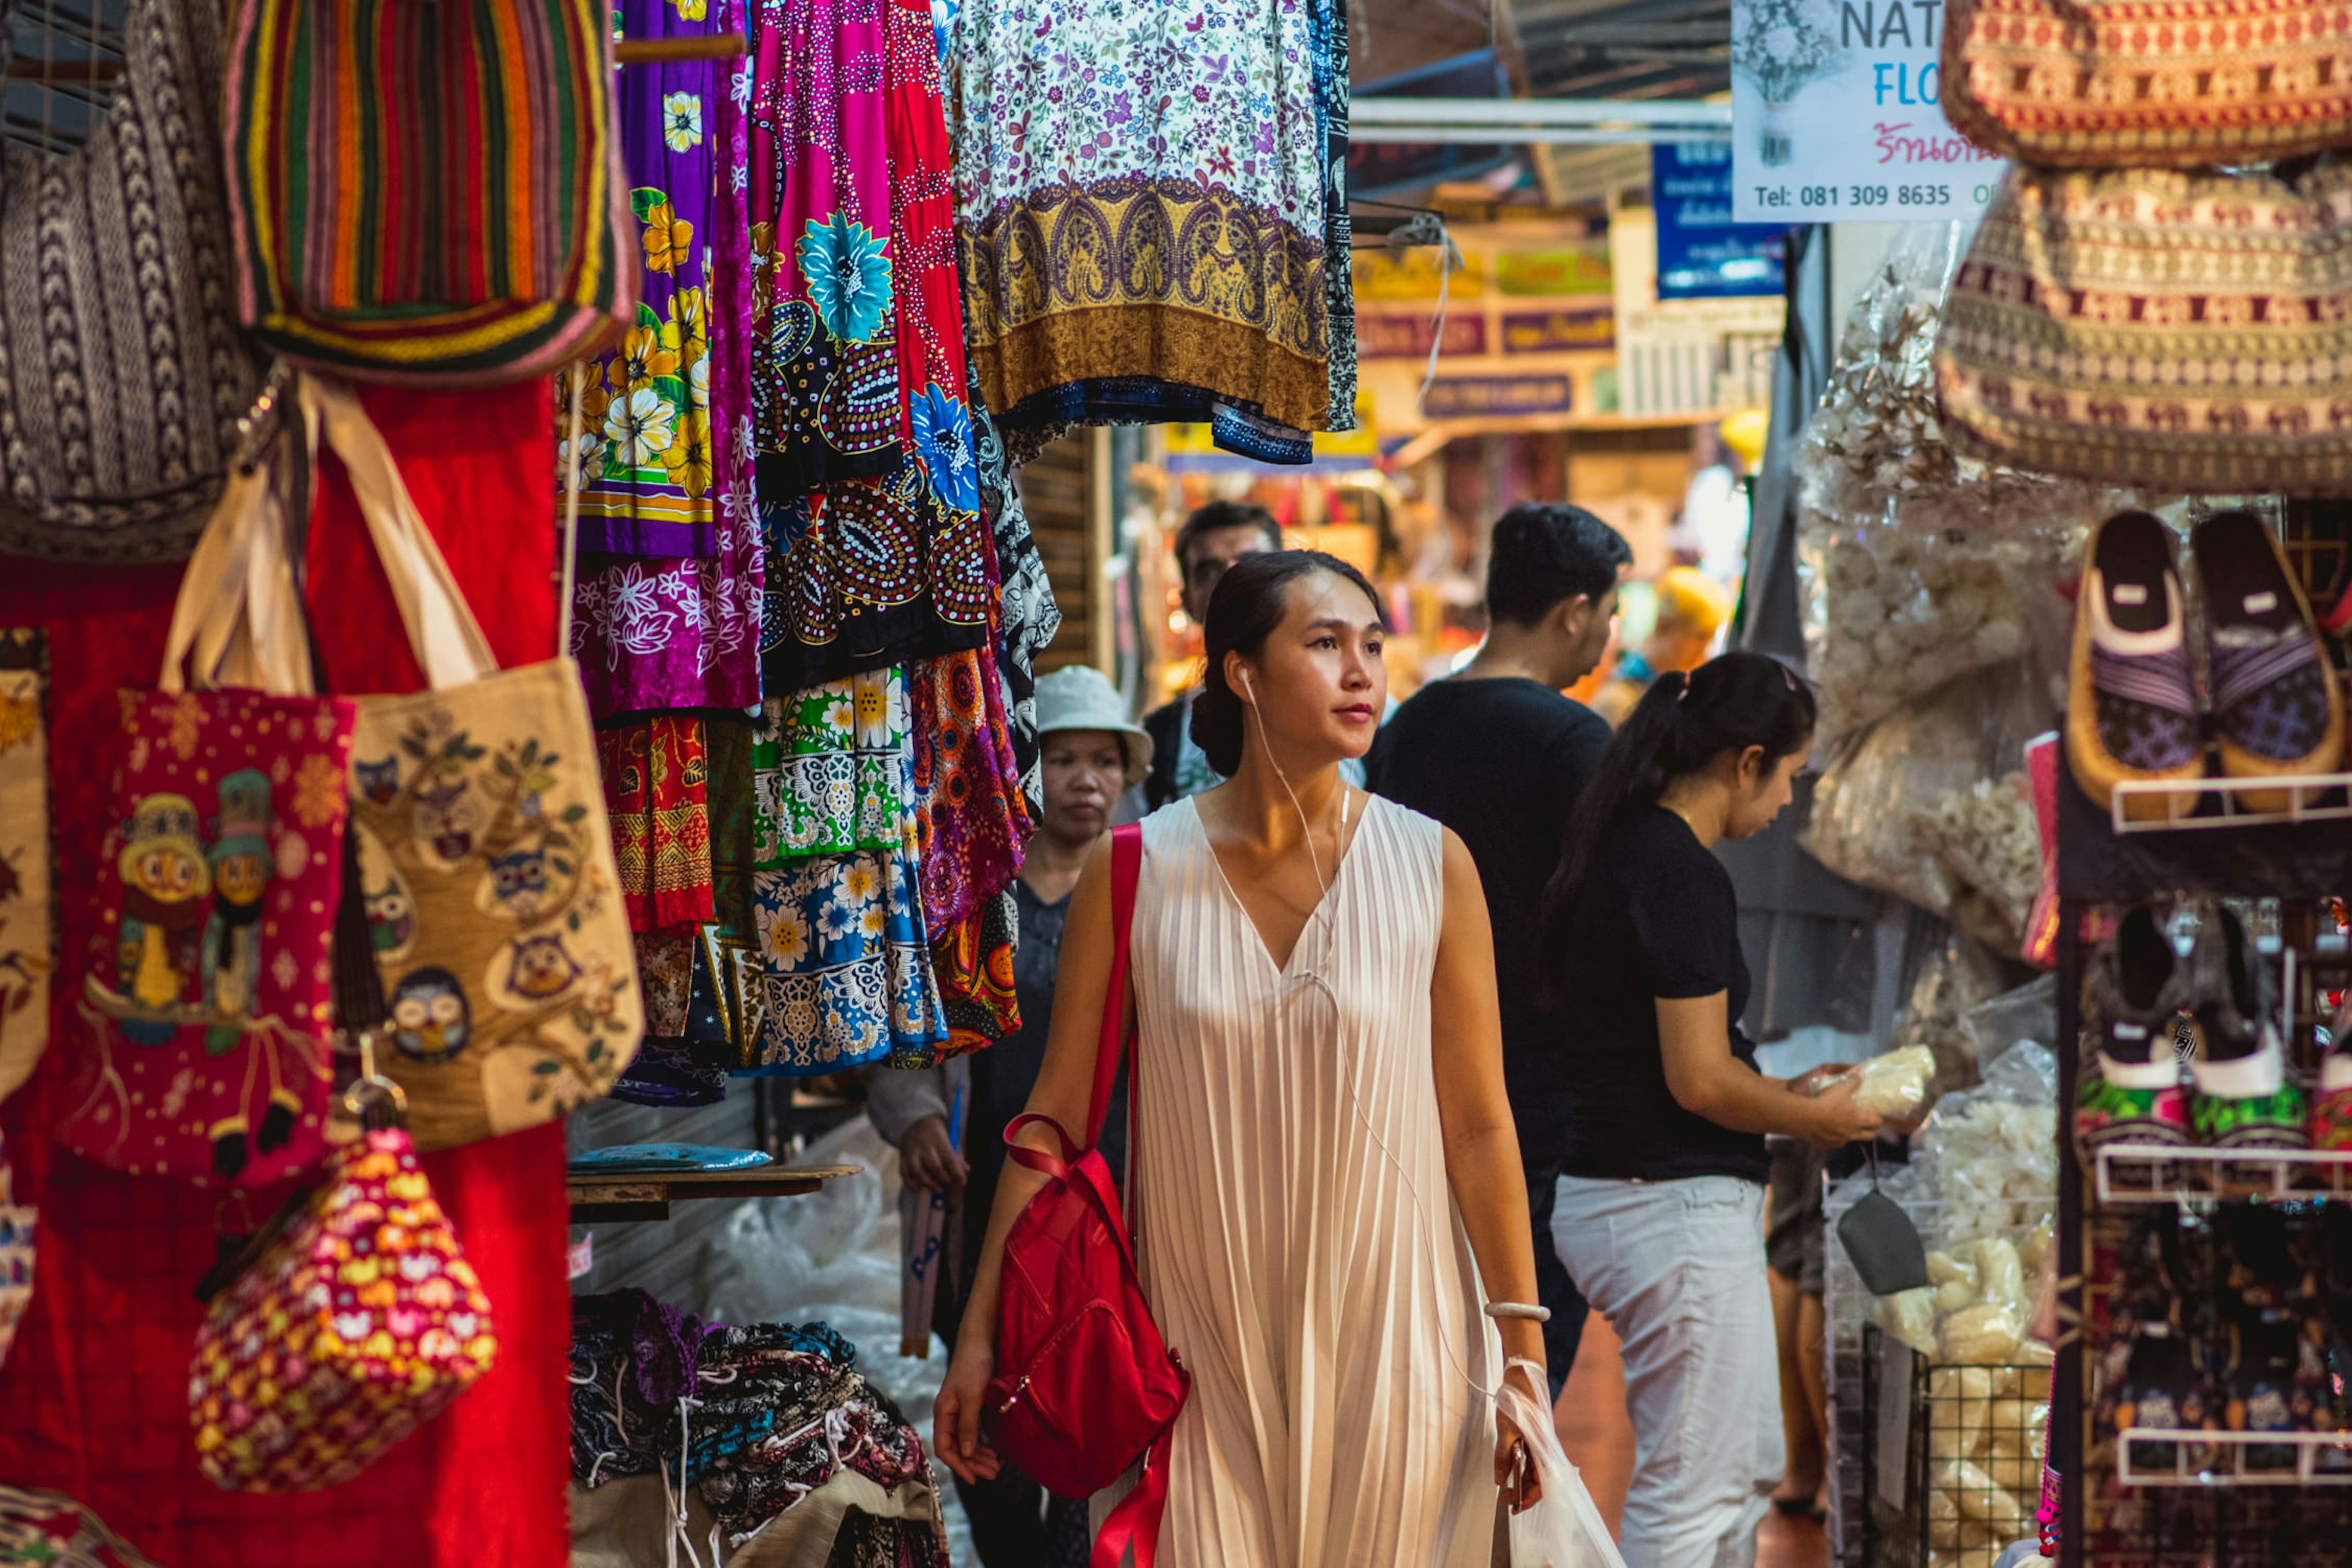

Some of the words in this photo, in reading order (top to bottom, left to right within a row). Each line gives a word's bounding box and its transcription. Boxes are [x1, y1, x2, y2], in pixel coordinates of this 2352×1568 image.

[1841, 1, 1942, 48] NAT
[1872, 62, 1939, 106] FLO
[1754, 185, 1792, 207] Tel:
[1800, 186, 1838, 206] 081
[1849, 185, 1888, 206] 309
[1898, 185, 1950, 206] 8635
